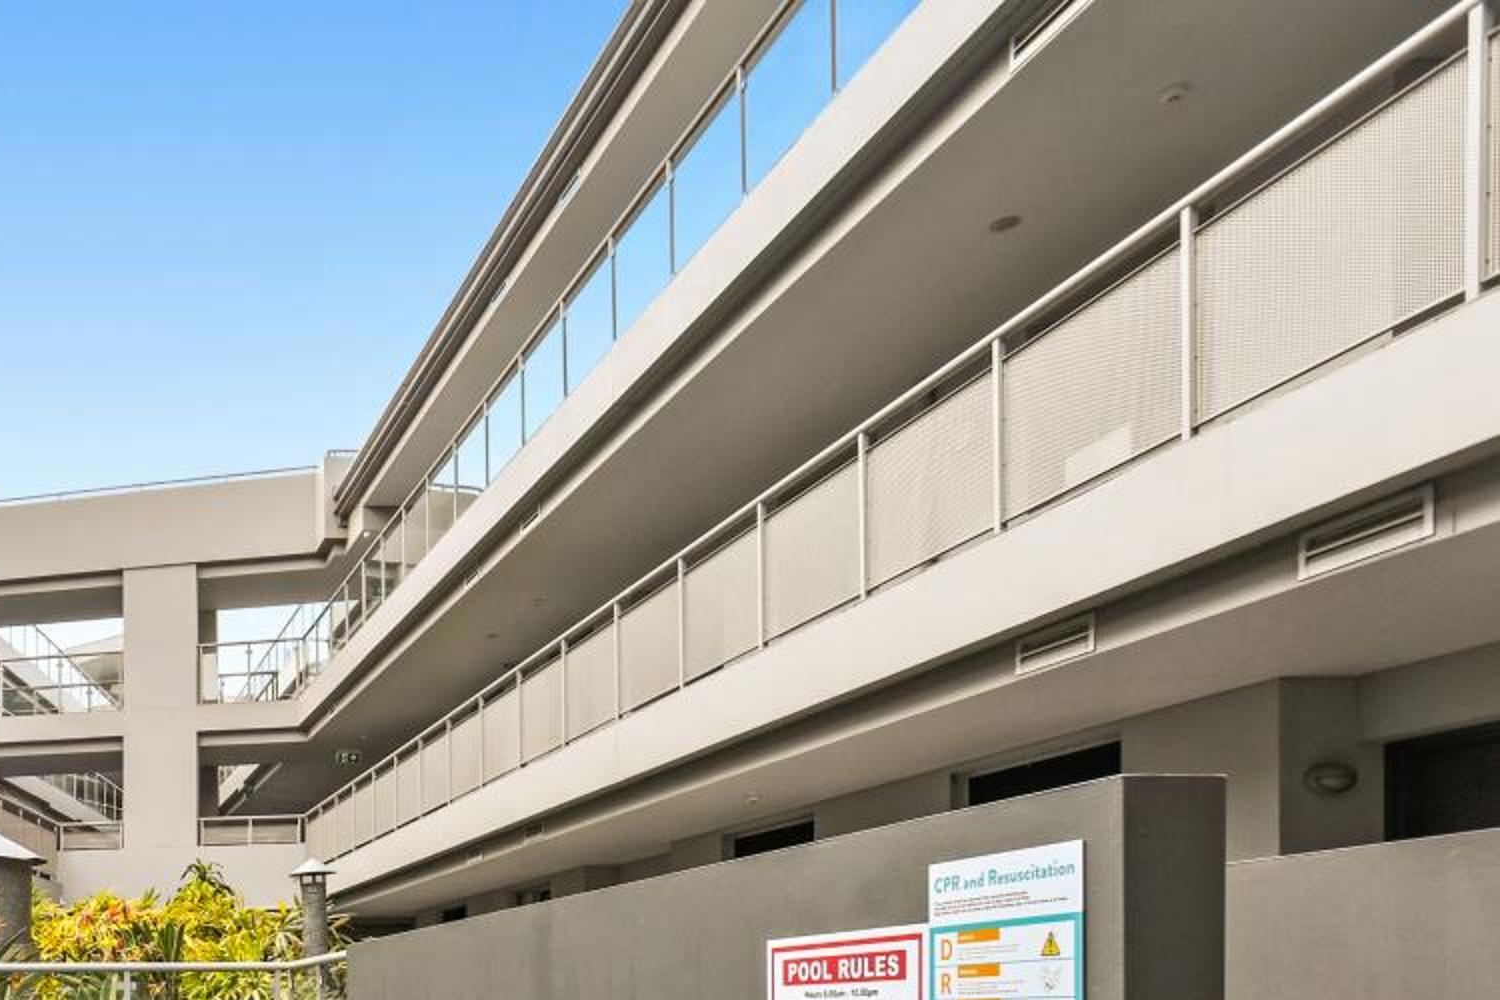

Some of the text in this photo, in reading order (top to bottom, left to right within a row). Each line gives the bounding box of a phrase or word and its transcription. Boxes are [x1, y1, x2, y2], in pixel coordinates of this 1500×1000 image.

[934, 859, 1075, 893] CPR and Resuscitation
[941, 939, 952, 960] D
[787, 955, 900, 982] POOL RULES
[941, 973, 951, 994] R
